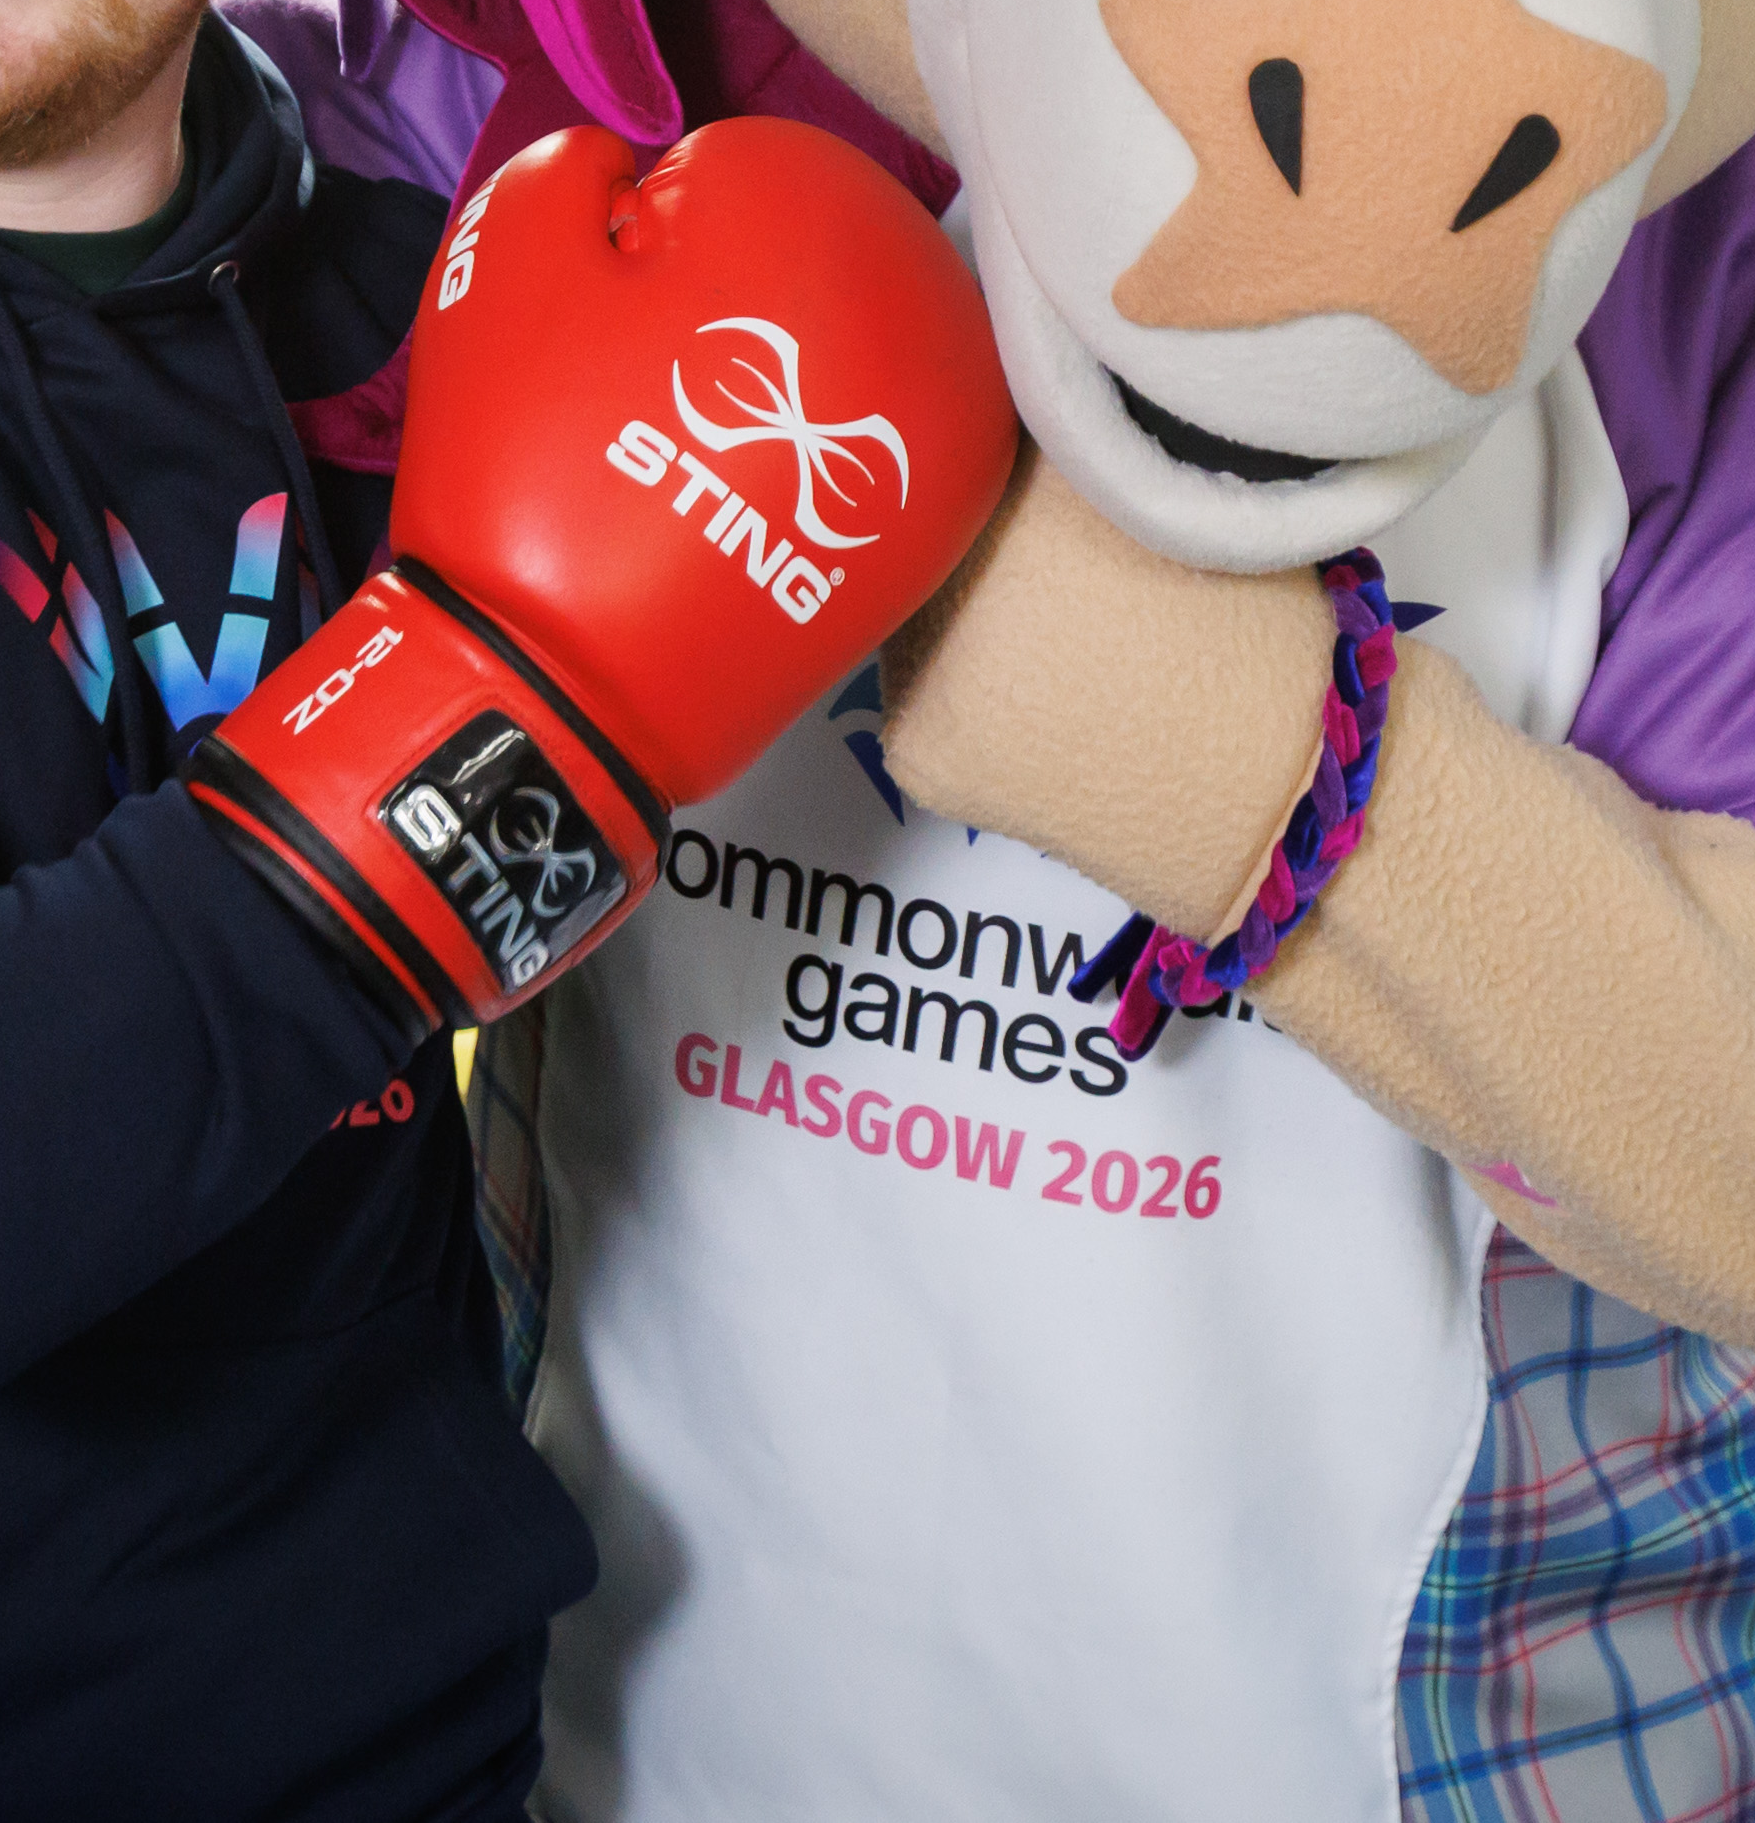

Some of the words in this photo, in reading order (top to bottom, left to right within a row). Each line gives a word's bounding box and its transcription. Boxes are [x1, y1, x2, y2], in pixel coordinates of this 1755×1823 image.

[393, 783, 550, 996] STING
[782, 952, 1129, 1097] games
[674, 1032, 1027, 1191] GLASGOW
[1041, 1139, 1223, 1221] 2026
